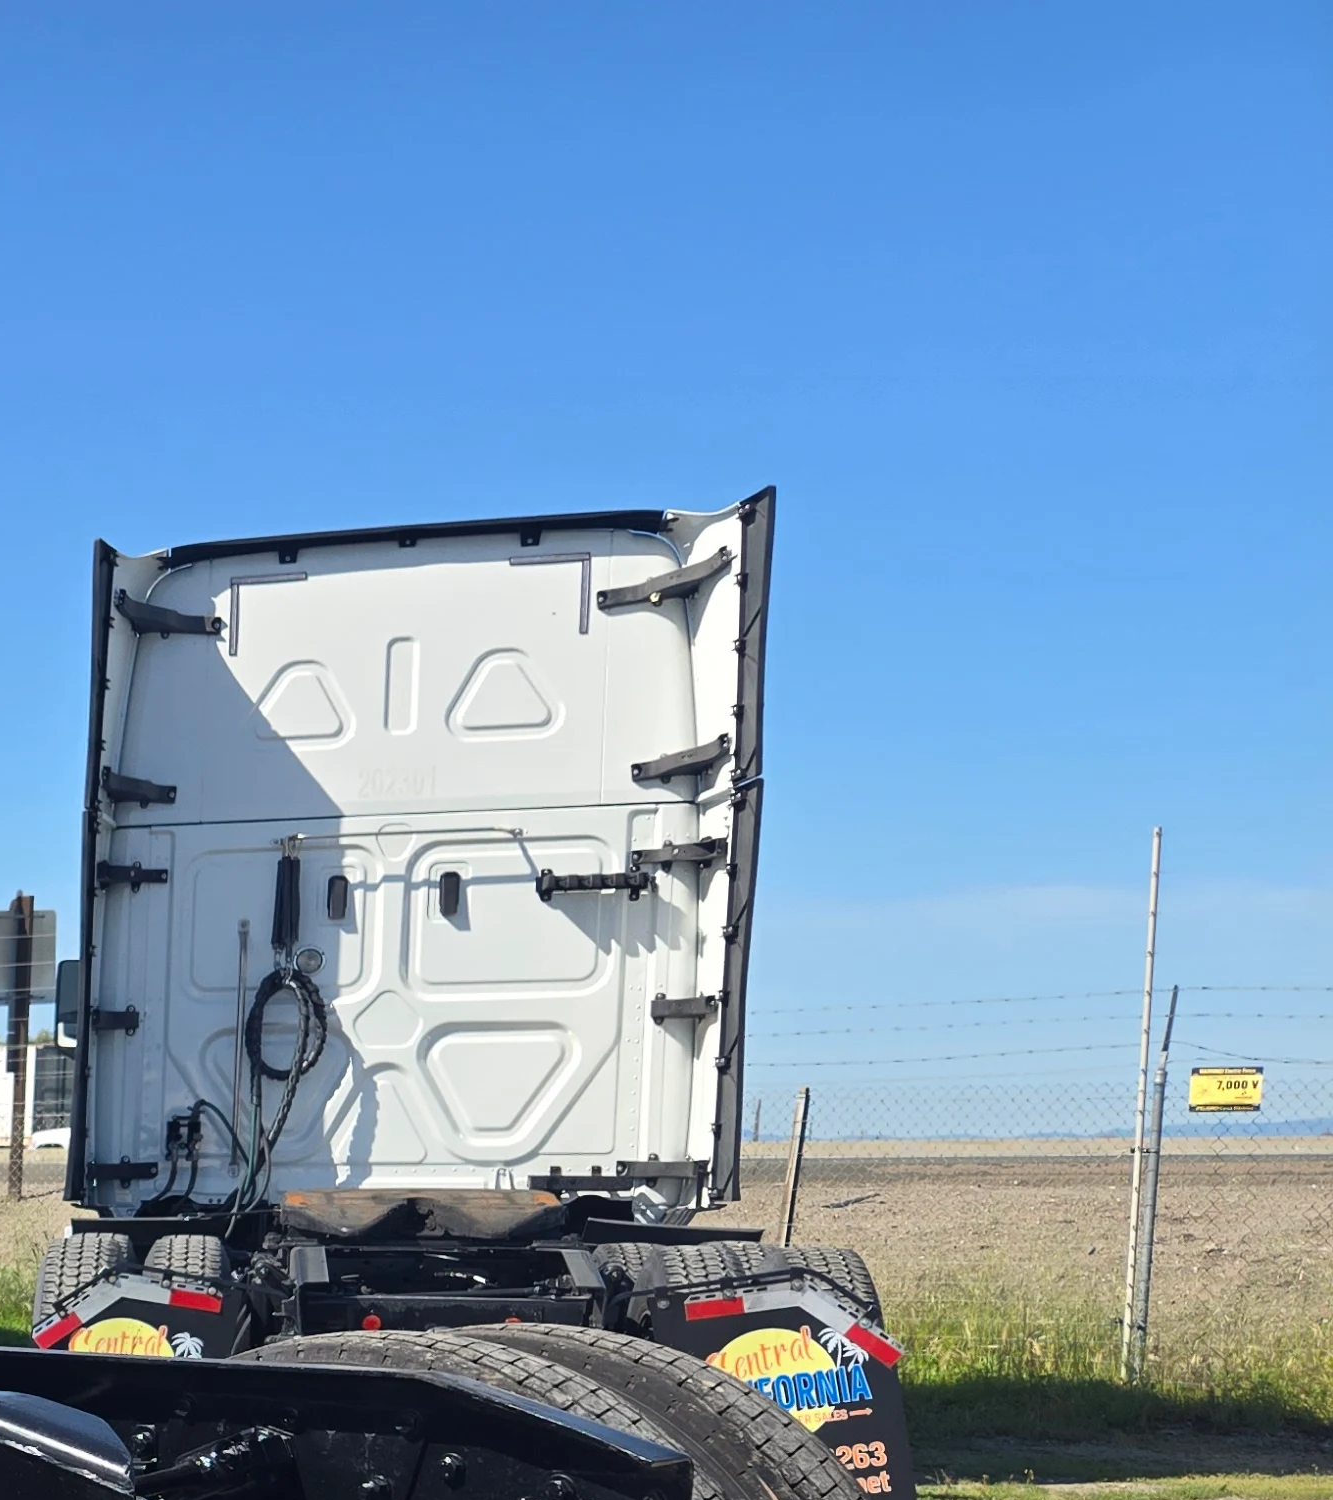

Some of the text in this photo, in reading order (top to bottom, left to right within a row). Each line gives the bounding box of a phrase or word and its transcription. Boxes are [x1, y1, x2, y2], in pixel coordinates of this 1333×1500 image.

[1216, 1080, 1248, 1091] 7,000
[68, 1324, 169, 1355] Central
[706, 1325, 813, 1379] Central
